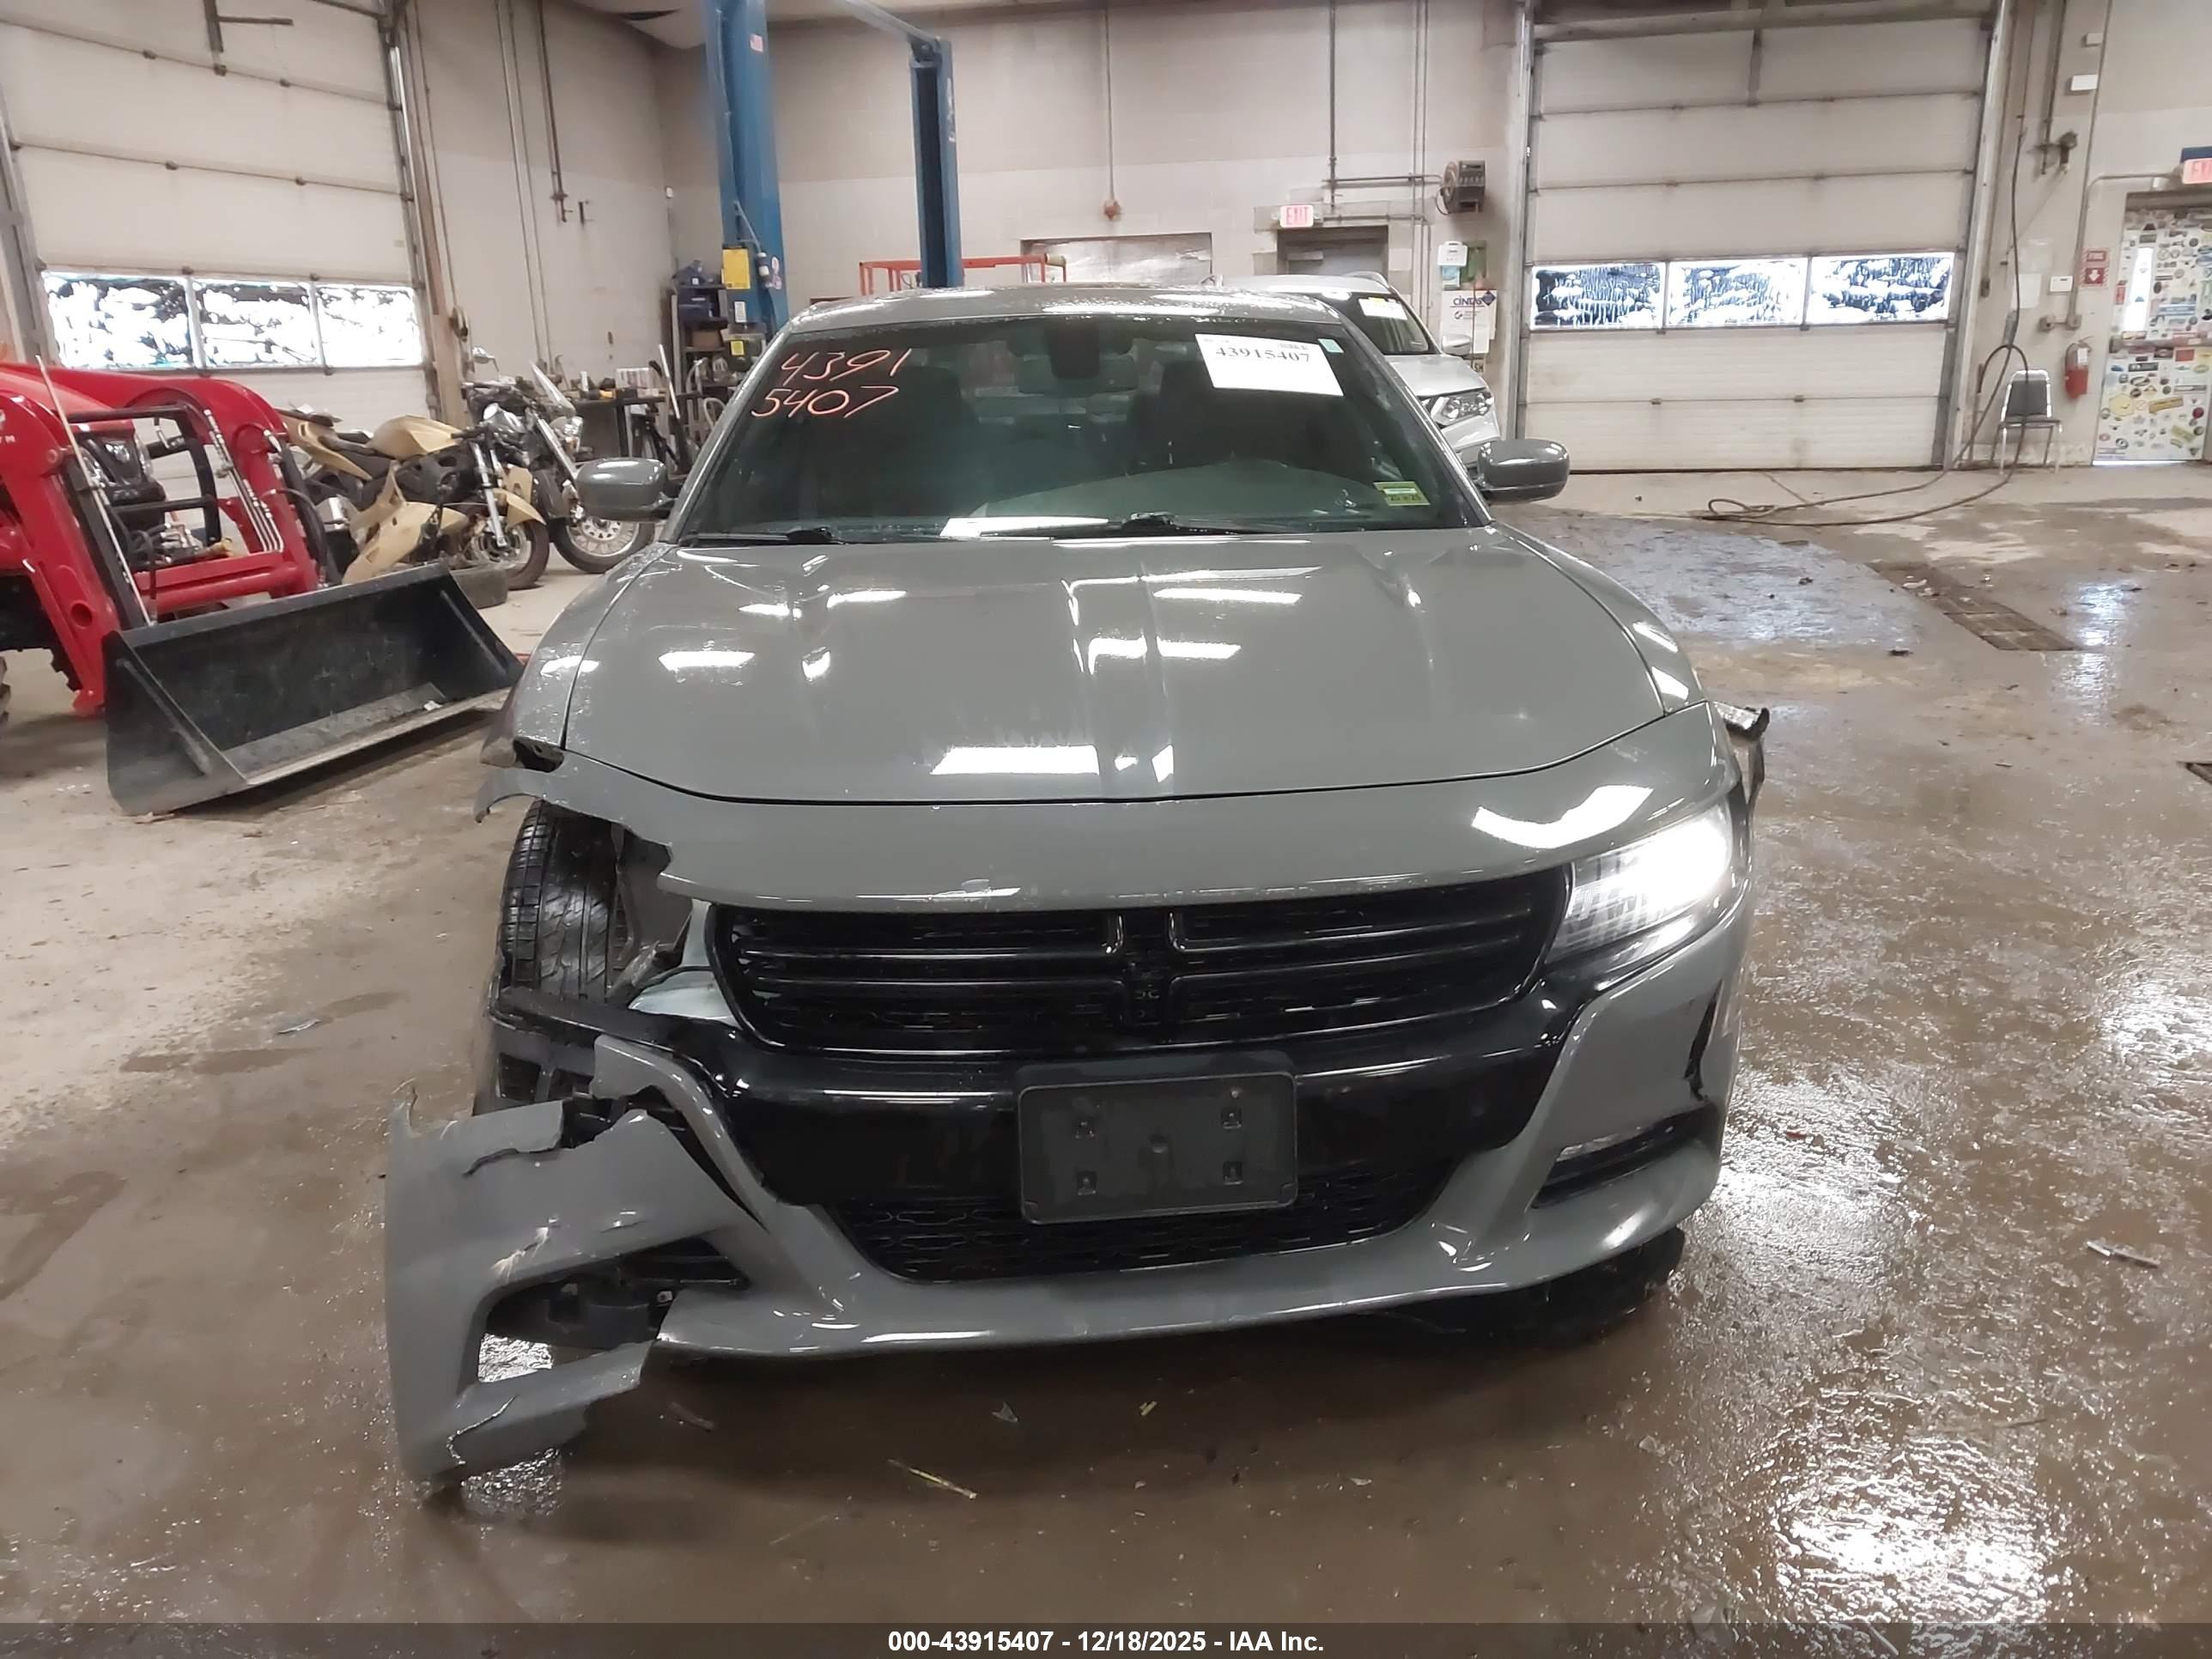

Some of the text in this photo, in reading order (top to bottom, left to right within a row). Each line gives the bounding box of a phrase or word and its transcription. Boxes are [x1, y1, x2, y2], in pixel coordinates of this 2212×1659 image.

[1286, 206, 1309, 225] EXIT
[781, 348, 912, 386] 4391
[1216, 347, 1310, 362] 43915407
[751, 385, 899, 418] 5407
